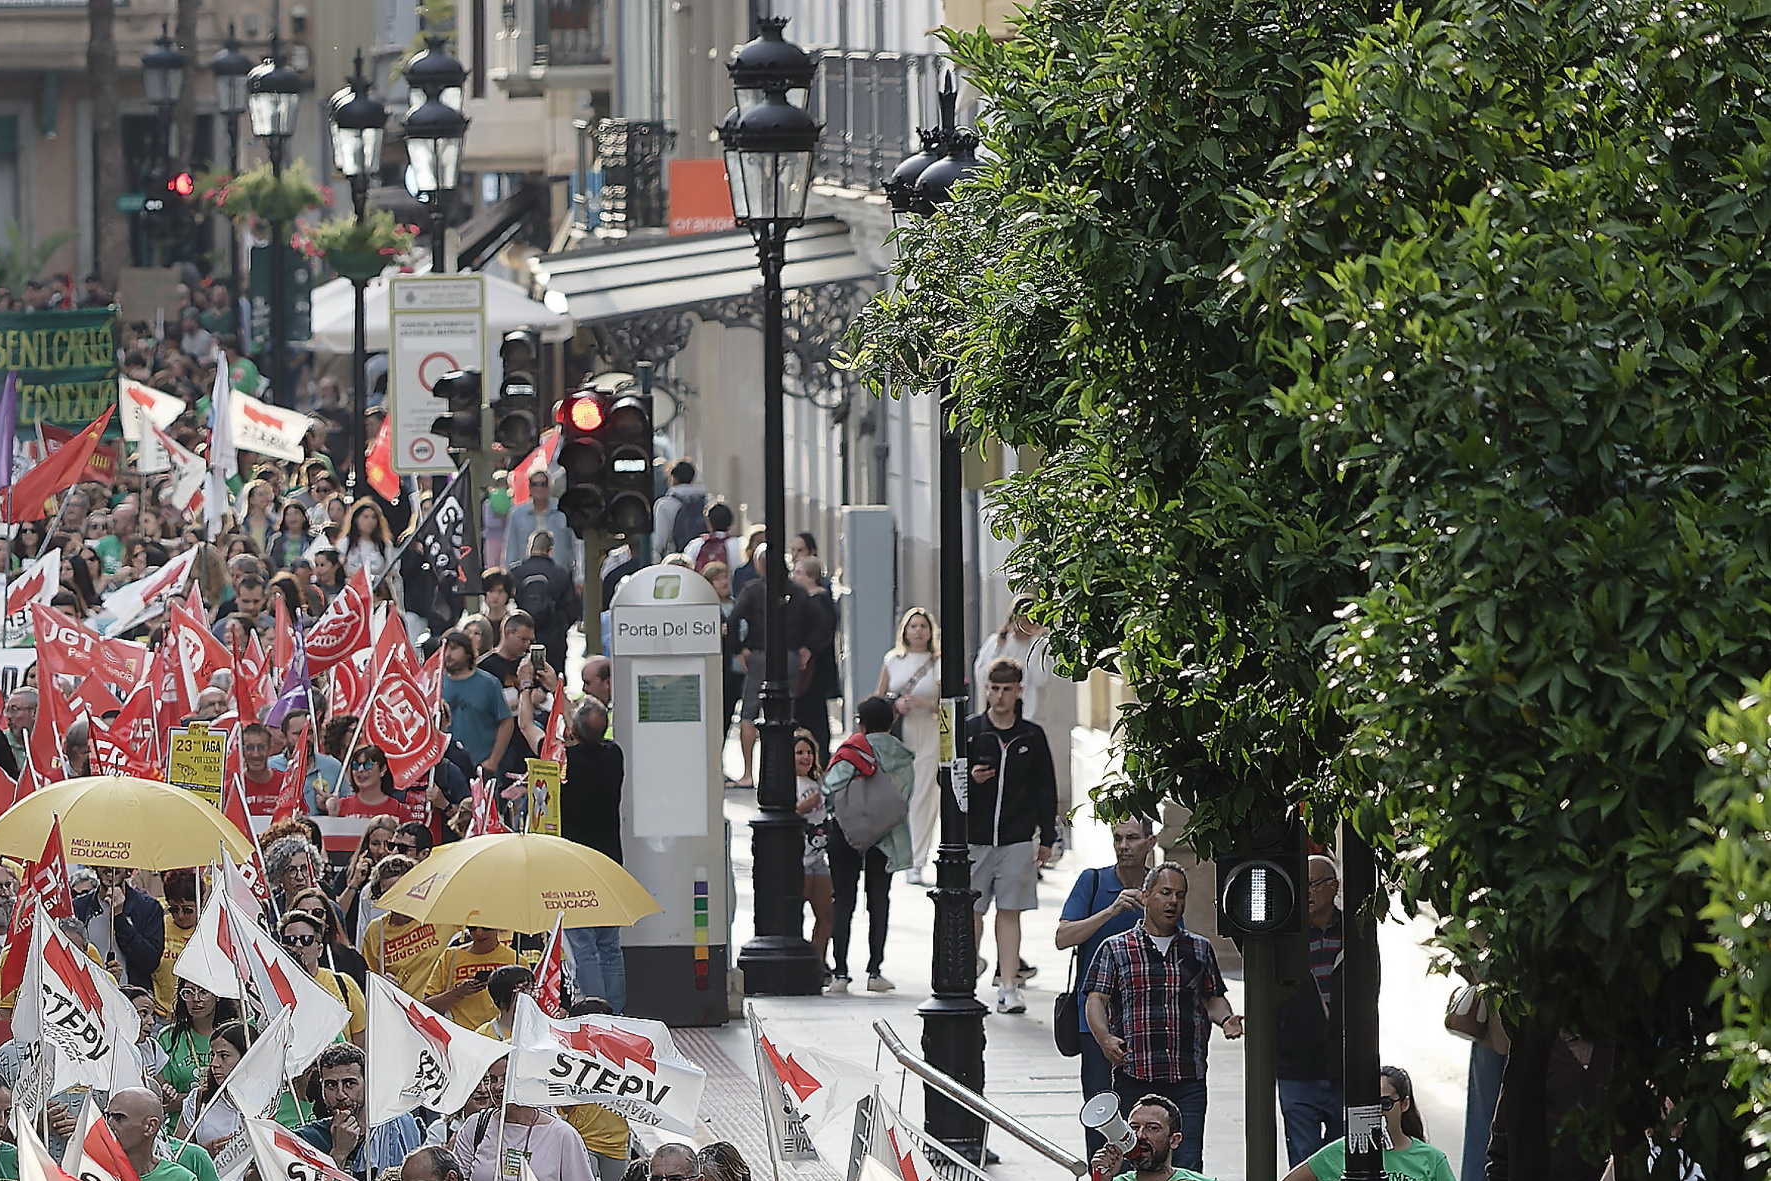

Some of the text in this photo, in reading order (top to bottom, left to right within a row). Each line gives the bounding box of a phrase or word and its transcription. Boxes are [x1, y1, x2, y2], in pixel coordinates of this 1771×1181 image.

[619, 621, 716, 637] Porta Del Sol
[176, 739, 221, 753] 23 VAGA
[71, 838, 91, 848] MÉS
[96, 839, 131, 850] MILLOR
[70, 847, 130, 860] EDUCACIÓ
[545, 898, 600, 911] EDUCACIÓ
[548, 1052, 671, 1106] STEPV
[783, 1120, 805, 1136] INTE
